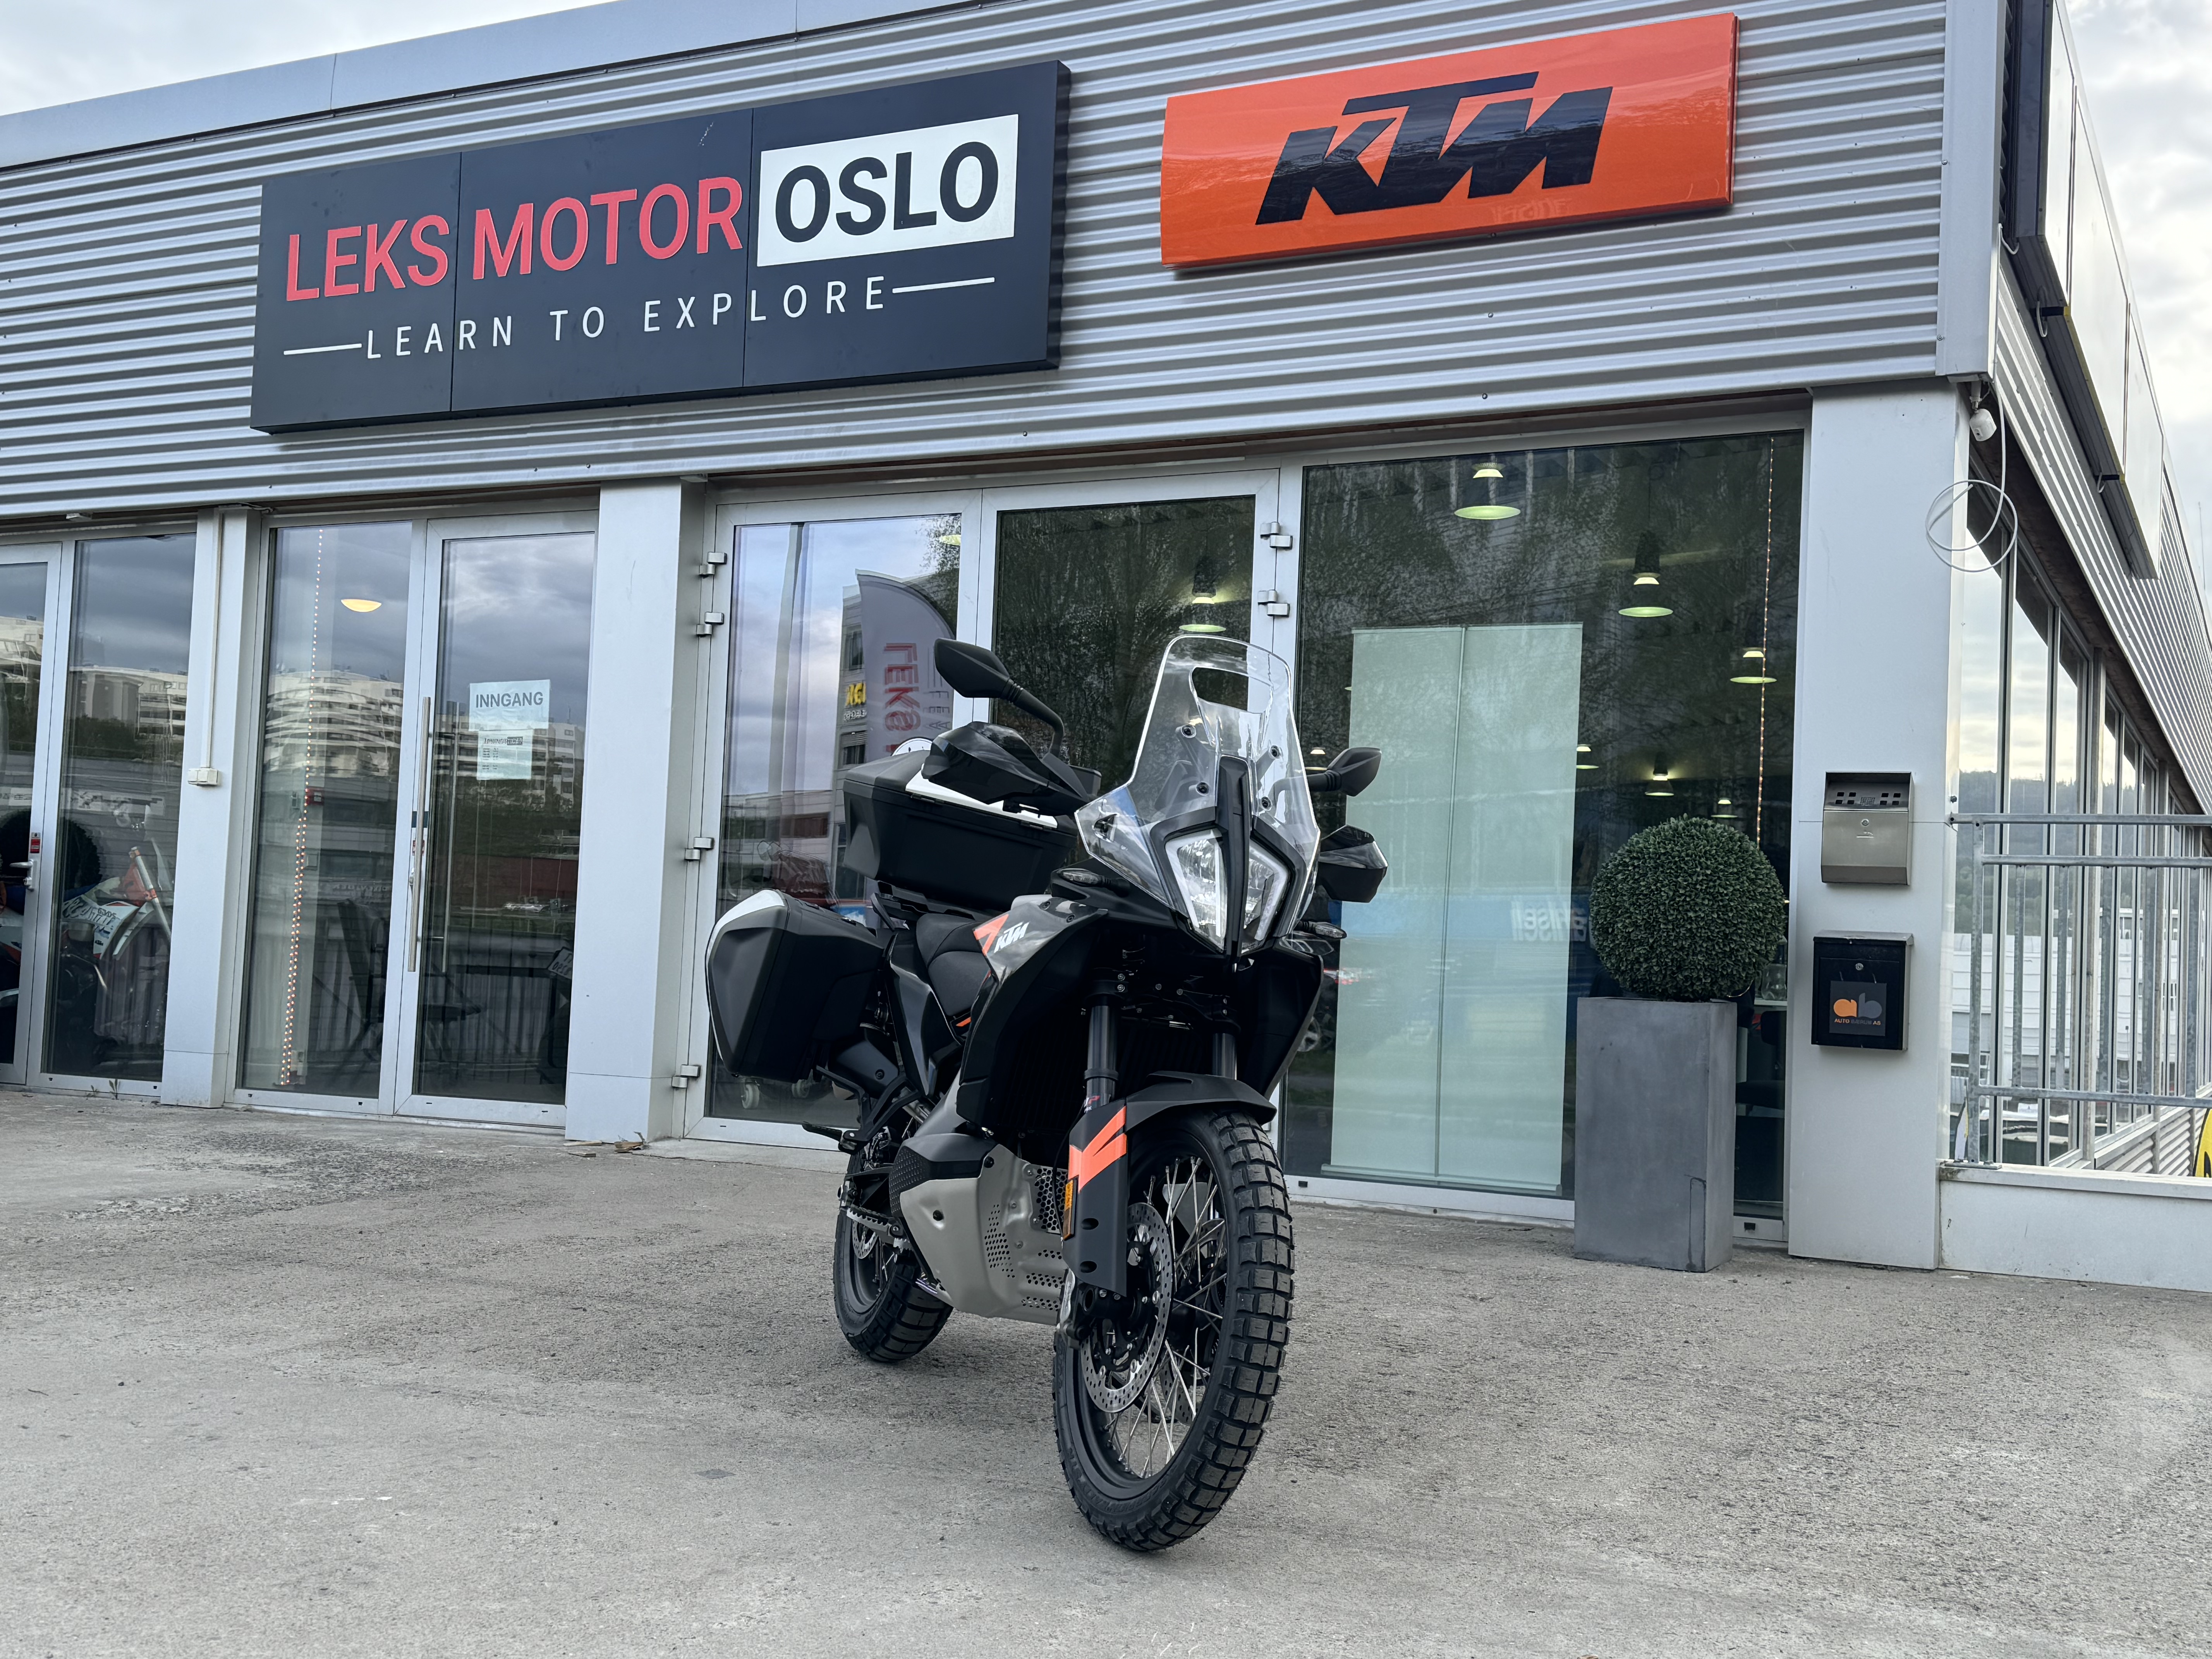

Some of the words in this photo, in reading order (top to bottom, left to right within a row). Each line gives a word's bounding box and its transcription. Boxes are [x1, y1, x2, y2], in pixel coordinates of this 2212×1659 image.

[1255, 71, 1613, 225] KTM
[287, 215, 448, 301] LEKS
[473, 177, 742, 280] MOTOR
[775, 141, 998, 243] OSLO
[368, 316, 512, 359] LEARN
[550, 306, 604, 341] TO
[644, 276, 884, 332] EXPLORE
[476, 692, 543, 708] INNGANG
[994, 922, 1029, 953] KTM
